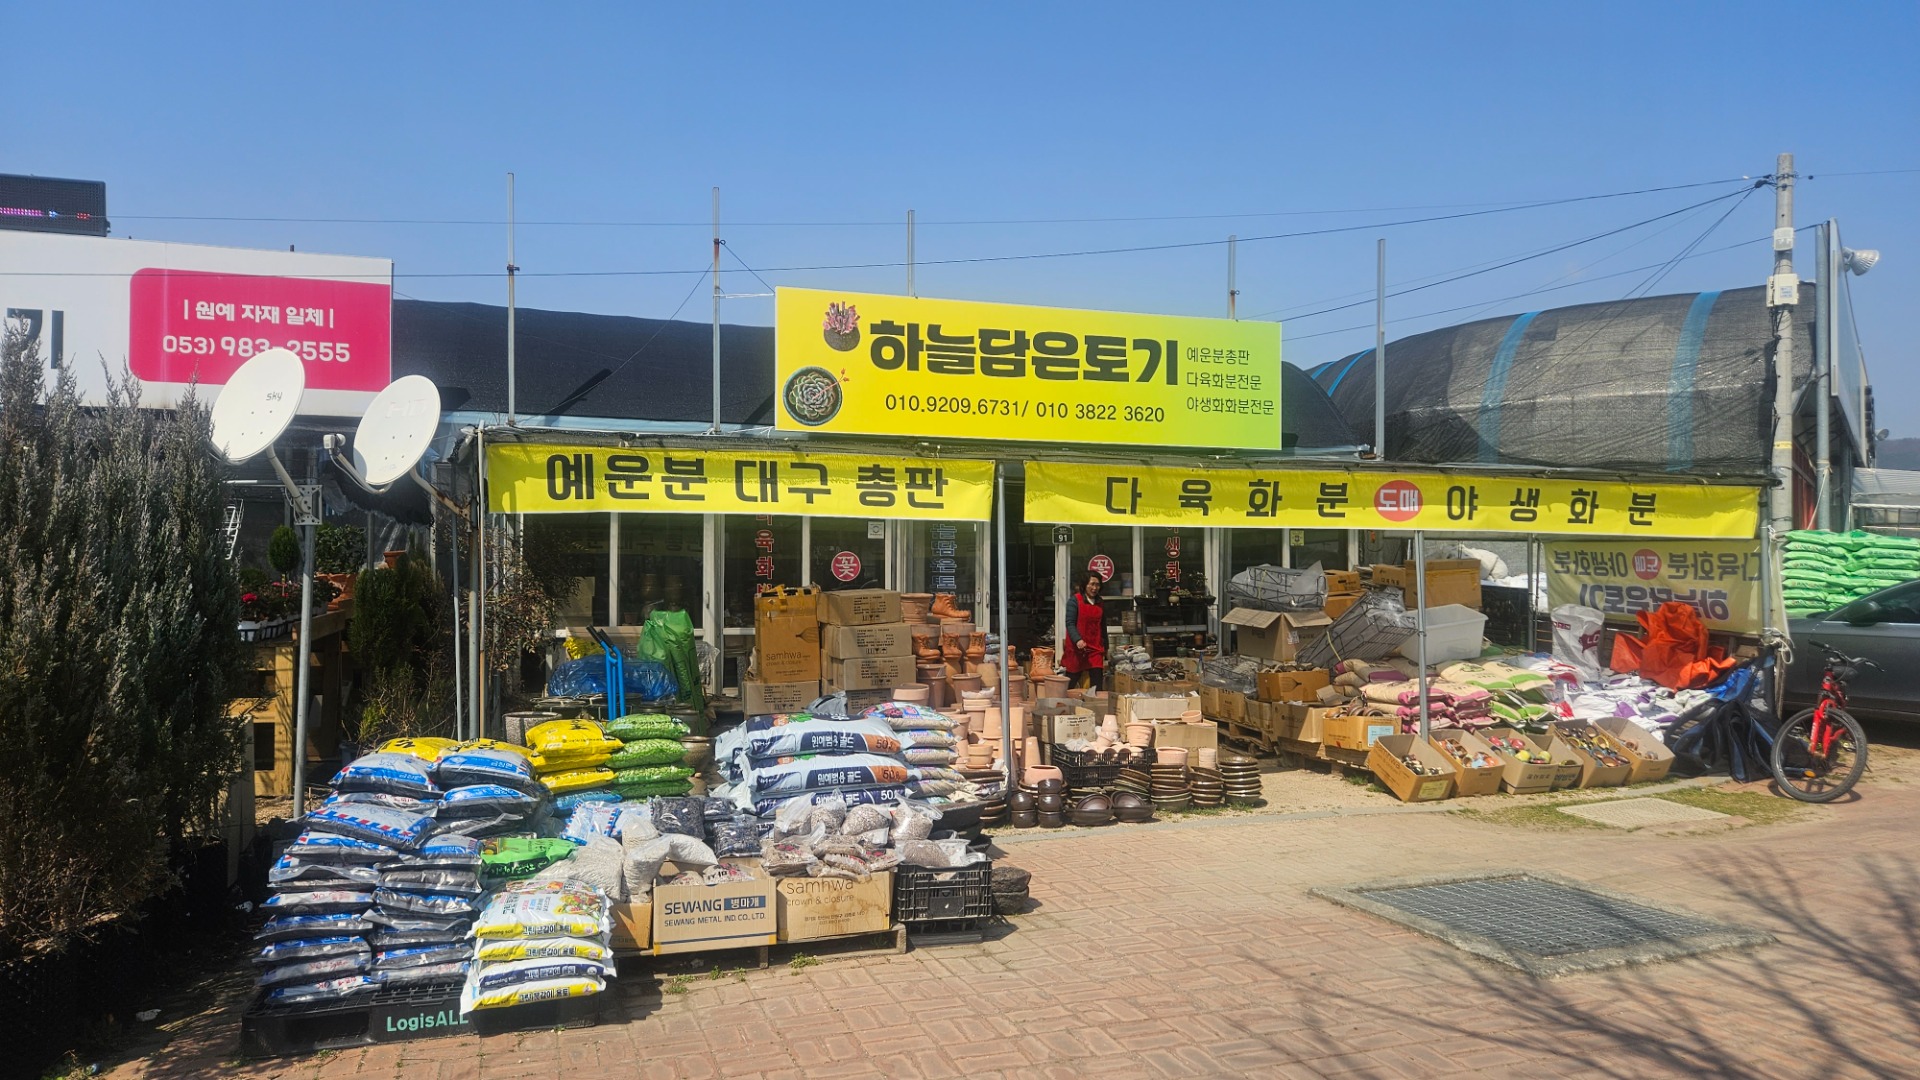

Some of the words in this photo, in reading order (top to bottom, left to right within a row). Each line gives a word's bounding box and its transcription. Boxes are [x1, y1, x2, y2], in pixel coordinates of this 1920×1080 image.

[196, 301, 235, 321] 원예
[241, 304, 279, 324] 자재
[286, 307, 323, 326] 일체
[162, 335, 215, 355] 053)
[868, 319, 1179, 386] 하늘담은토기
[1186, 347, 1250, 365] 예운분총판
[1186, 372, 1262, 390] 다육화분전문
[1036, 401, 1068, 418] 010
[1075, 403, 1117, 420] 3822
[1124, 405, 1165, 423] 3620
[1186, 397, 1274, 415] 야생화화분전문
[546, 453, 708, 501] 예운분
[735, 460, 832, 504] 대구
[855, 463, 949, 510] 총판
[1378, 488, 1419, 512] 도매
[1058, 534, 1068, 542] 91
[836, 556, 857, 578] 꽃
[786, 878, 854, 895] samhwa
[664, 899, 722, 915] SEWANG
[664, 917, 695, 927] SEWANG
[697, 916, 722, 924] METAL
[386, 1009, 470, 1032] LogisALL
